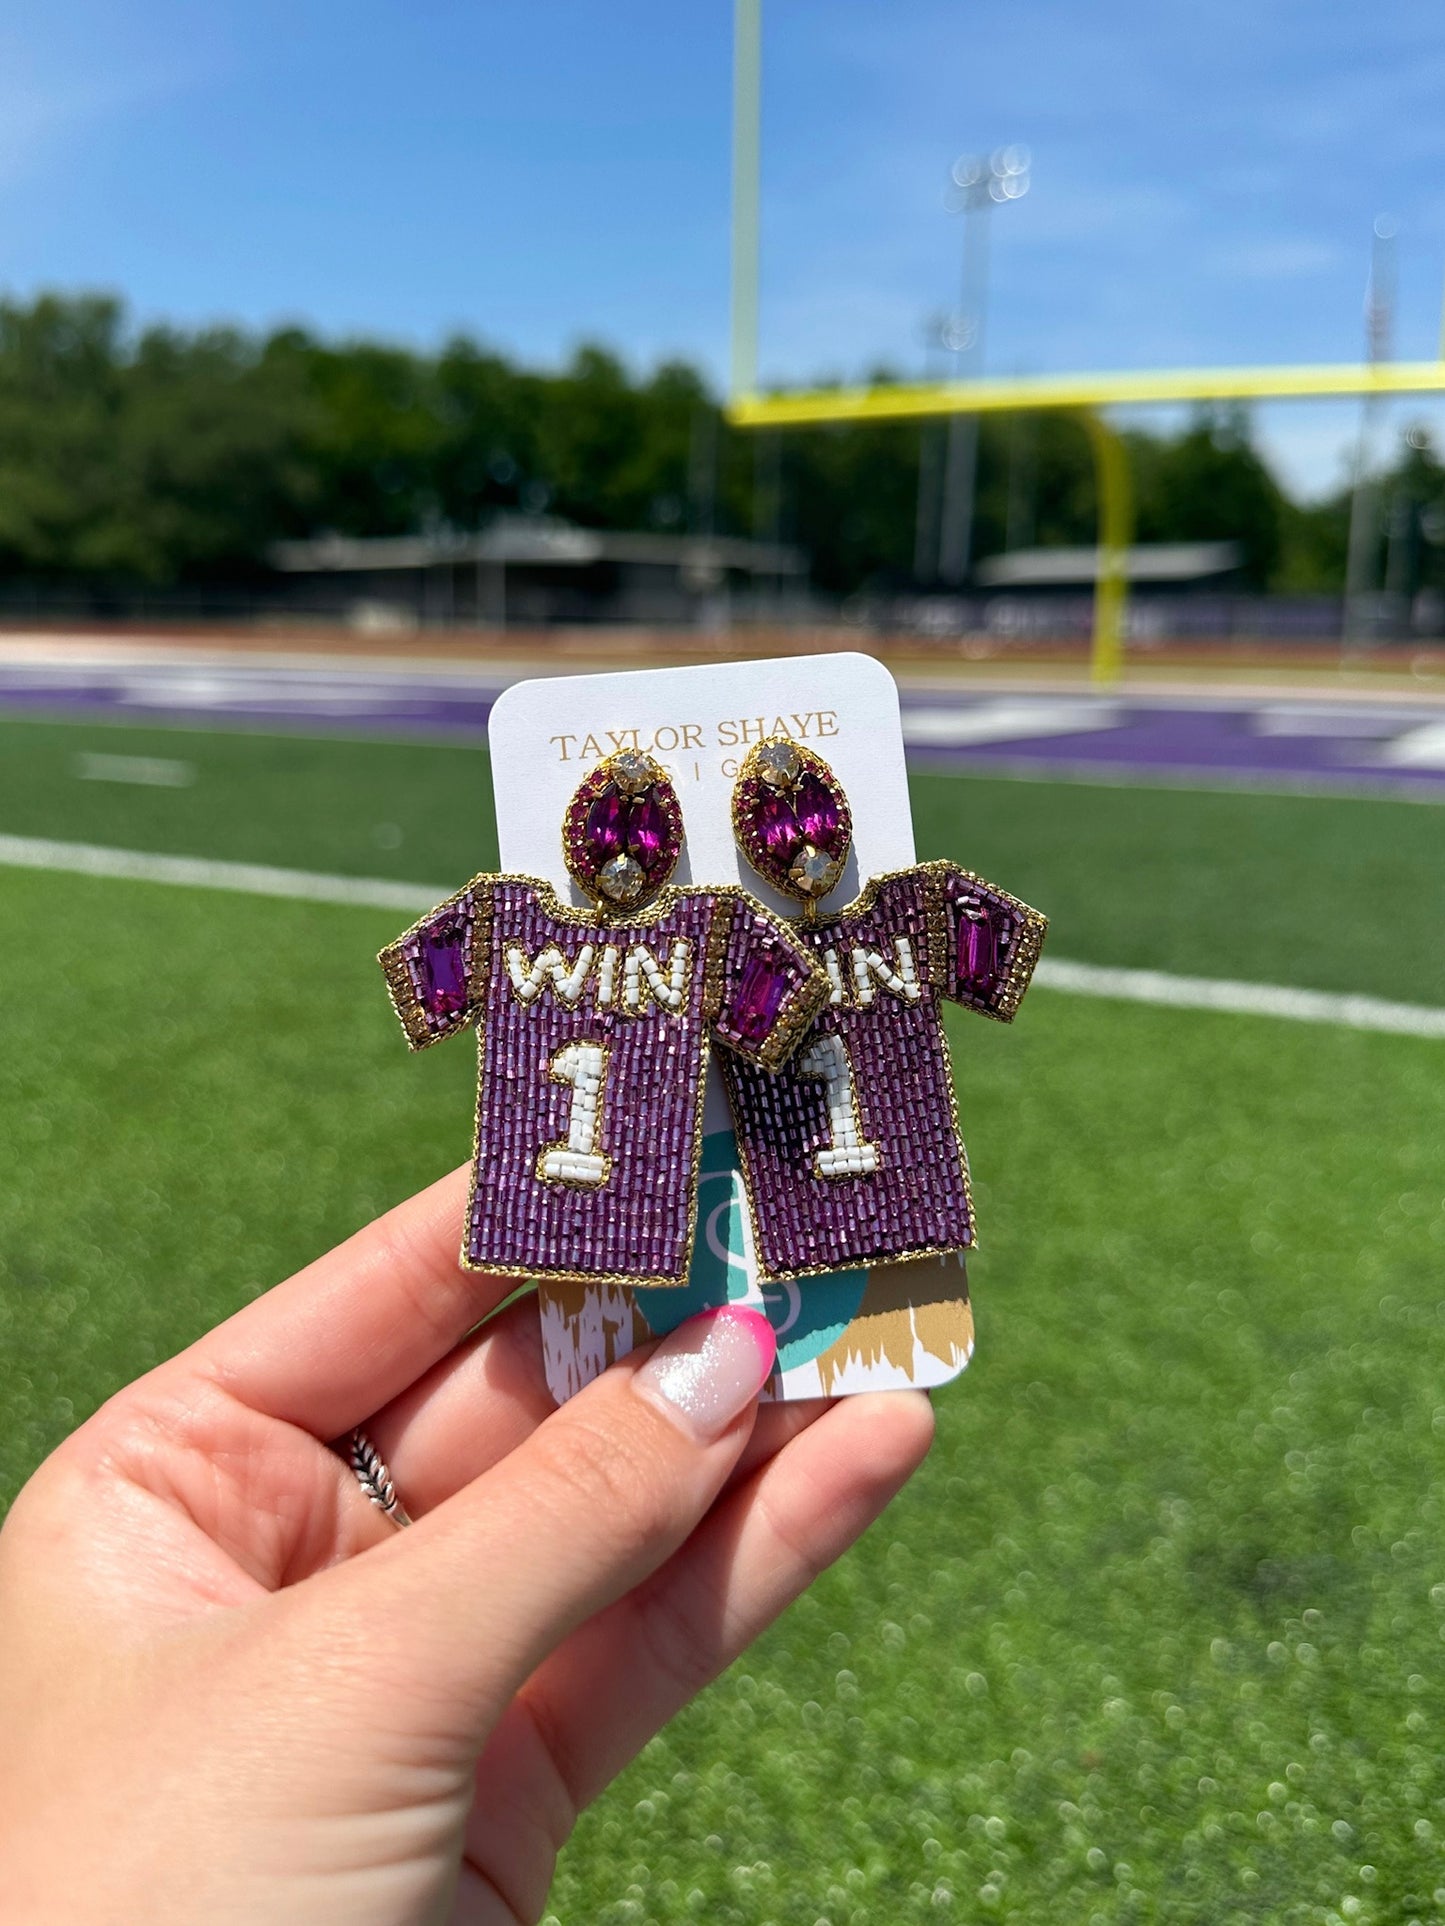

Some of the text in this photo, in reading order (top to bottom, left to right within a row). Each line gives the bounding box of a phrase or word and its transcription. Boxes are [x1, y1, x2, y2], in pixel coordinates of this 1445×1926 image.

[549, 710, 840, 762] TAYLOR SHAYE
[505, 943, 690, 1009] WIN
[824, 937, 922, 1005] IN
[541, 1044, 605, 1182] 1
[802, 1034, 880, 1176] 1
